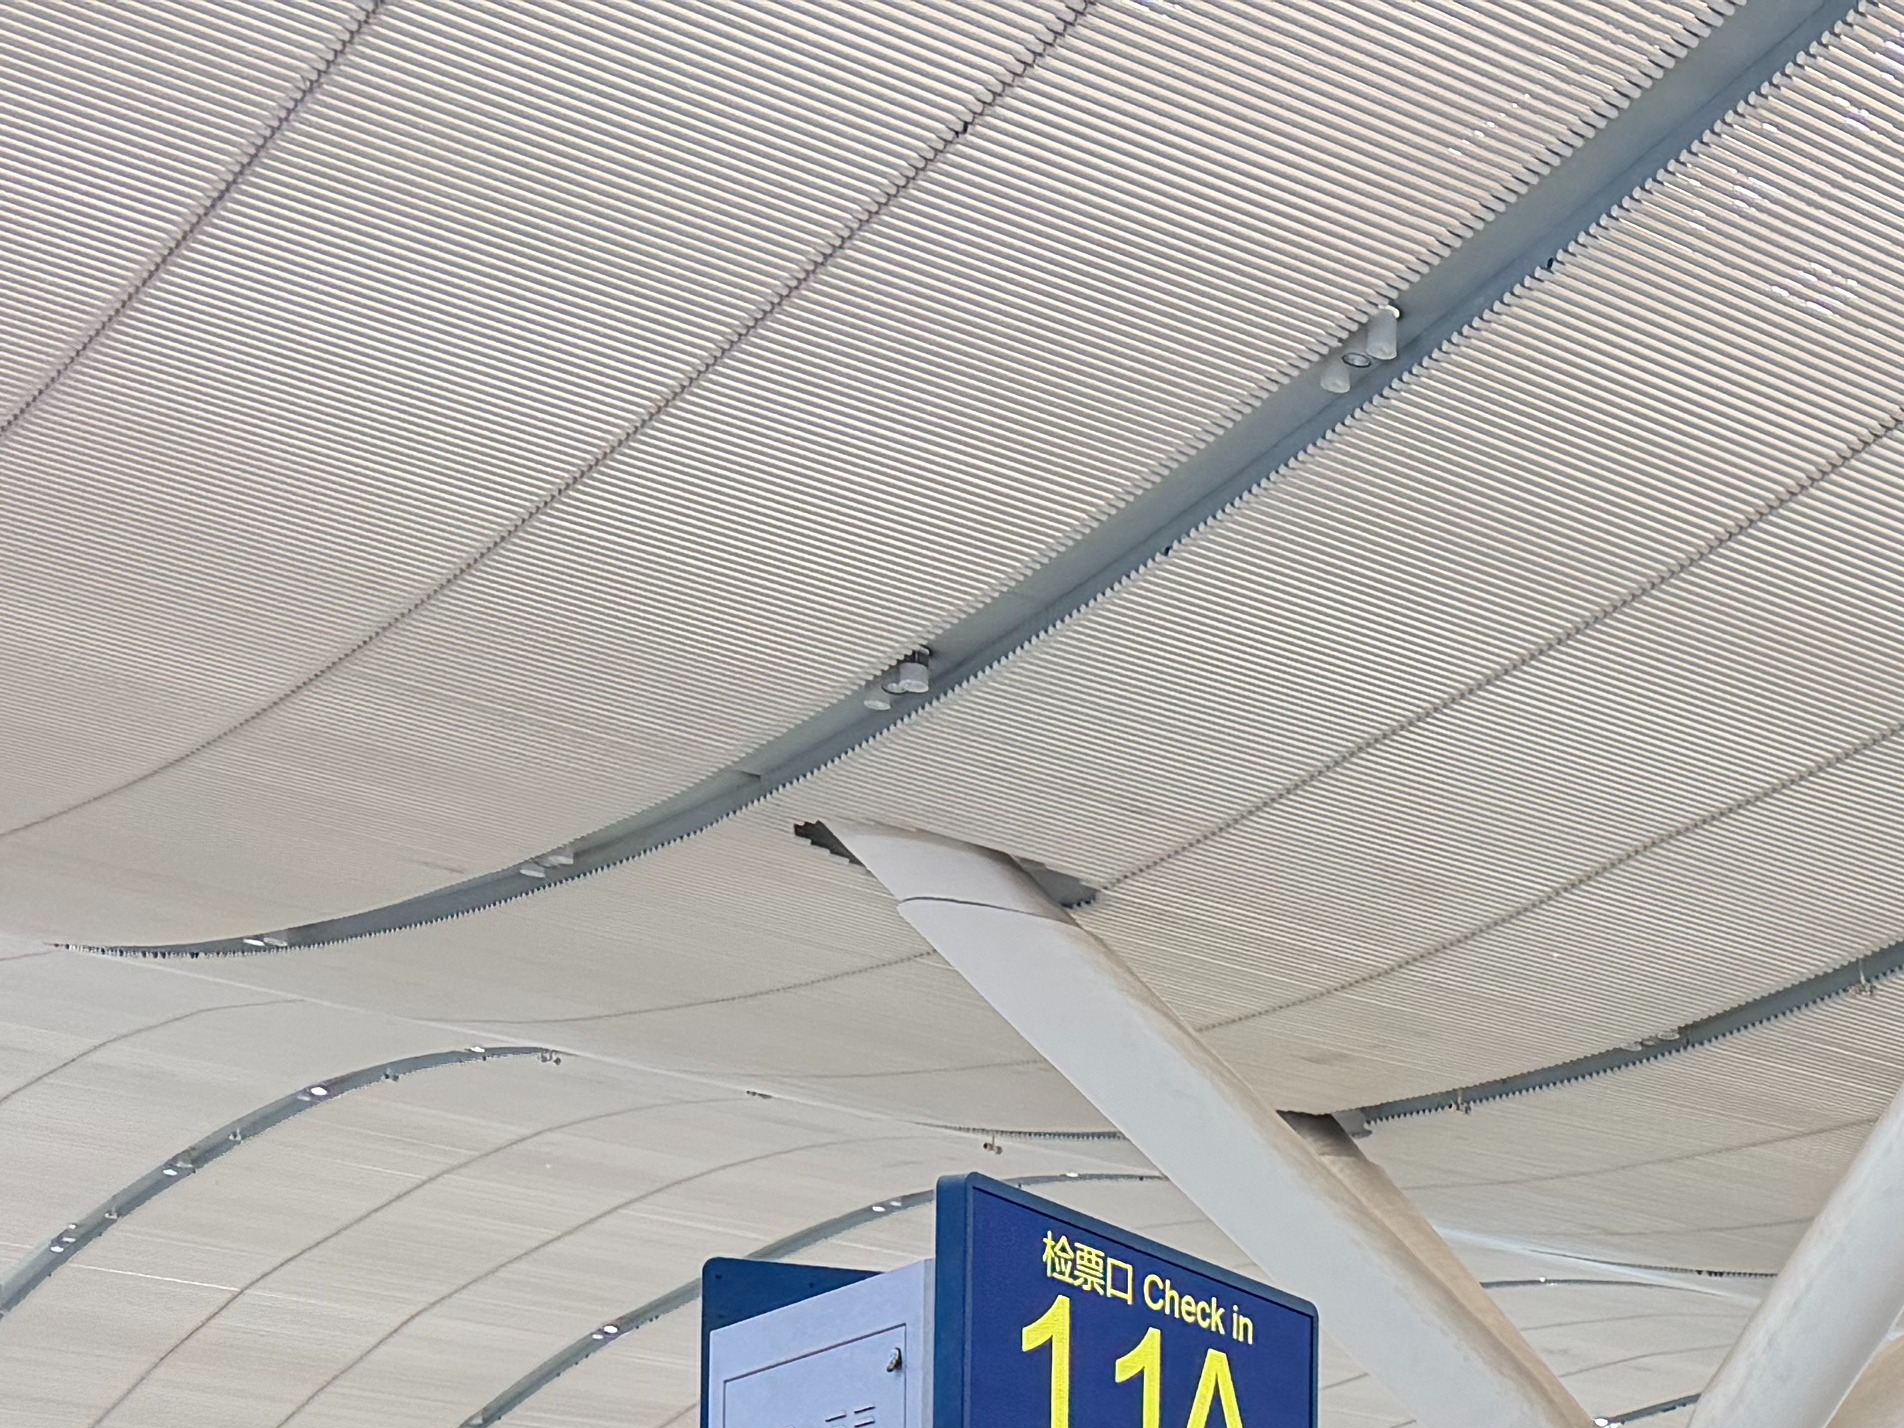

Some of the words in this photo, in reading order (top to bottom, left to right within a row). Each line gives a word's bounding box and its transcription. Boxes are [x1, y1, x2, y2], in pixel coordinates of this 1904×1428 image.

[1043, 1230, 1133, 1305] 检票口
[1144, 1274, 1226, 1335] Check
[1232, 1305, 1254, 1344] in
